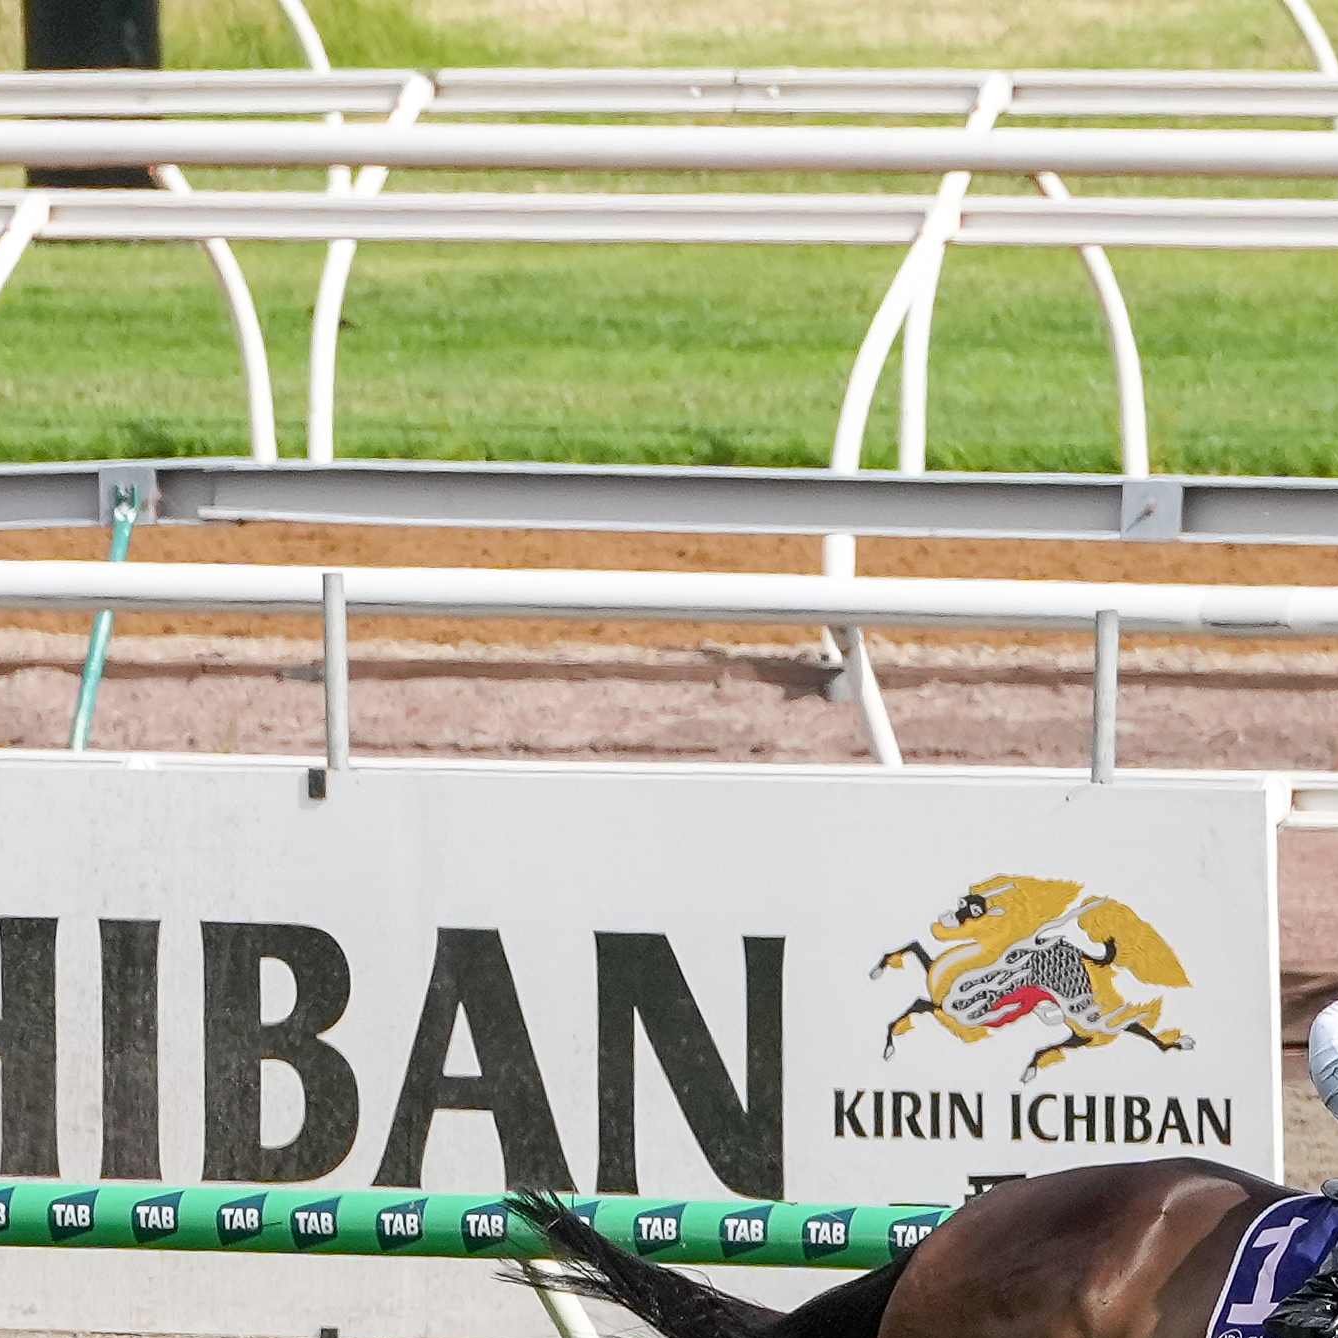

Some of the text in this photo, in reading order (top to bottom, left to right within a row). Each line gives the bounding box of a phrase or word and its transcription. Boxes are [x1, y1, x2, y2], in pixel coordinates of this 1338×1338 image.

[833, 1087, 1233, 1147] KIRIN ICHIBAN
[51, 1203, 91, 1228] TAB
[135, 1205, 175, 1230] TAB
[220, 1207, 260, 1231] TAB
[294, 1211, 334, 1236] TAB
[379, 1212, 420, 1237] TAB
[464, 1213, 505, 1238] TAB
[637, 1216, 678, 1241] TAB
[723, 1217, 764, 1244] TAB
[806, 1220, 847, 1246] TAB
[1225, 1216, 1310, 1325] 1
